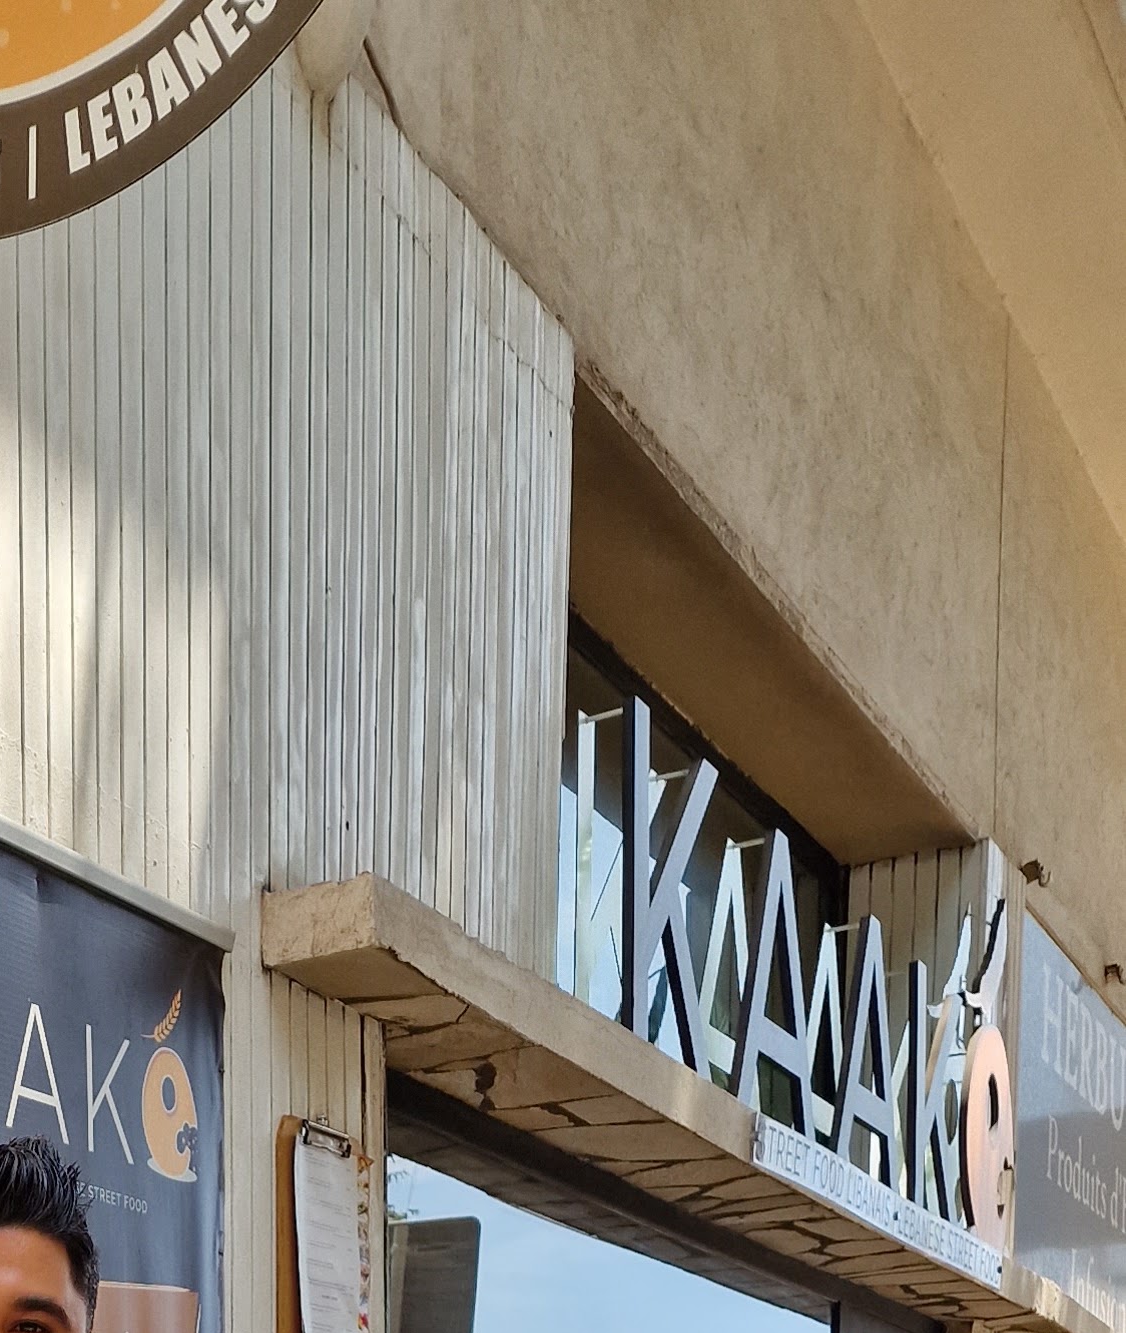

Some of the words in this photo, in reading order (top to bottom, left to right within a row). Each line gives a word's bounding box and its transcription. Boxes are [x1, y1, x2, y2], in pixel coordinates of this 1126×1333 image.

[87, 1184, 122, 1207] STREET
[123, 1194, 148, 1214] FOOD
[755, 1120, 811, 1179] STREET
[812, 1149, 845, 1198] FOOD
[846, 1165, 891, 1227] LIBANAIS
[896, 1202, 946, 1257] LEBANESE
[946, 1229, 980, 1273] STREET
[1046, 1114, 1107, 1220] Produits
